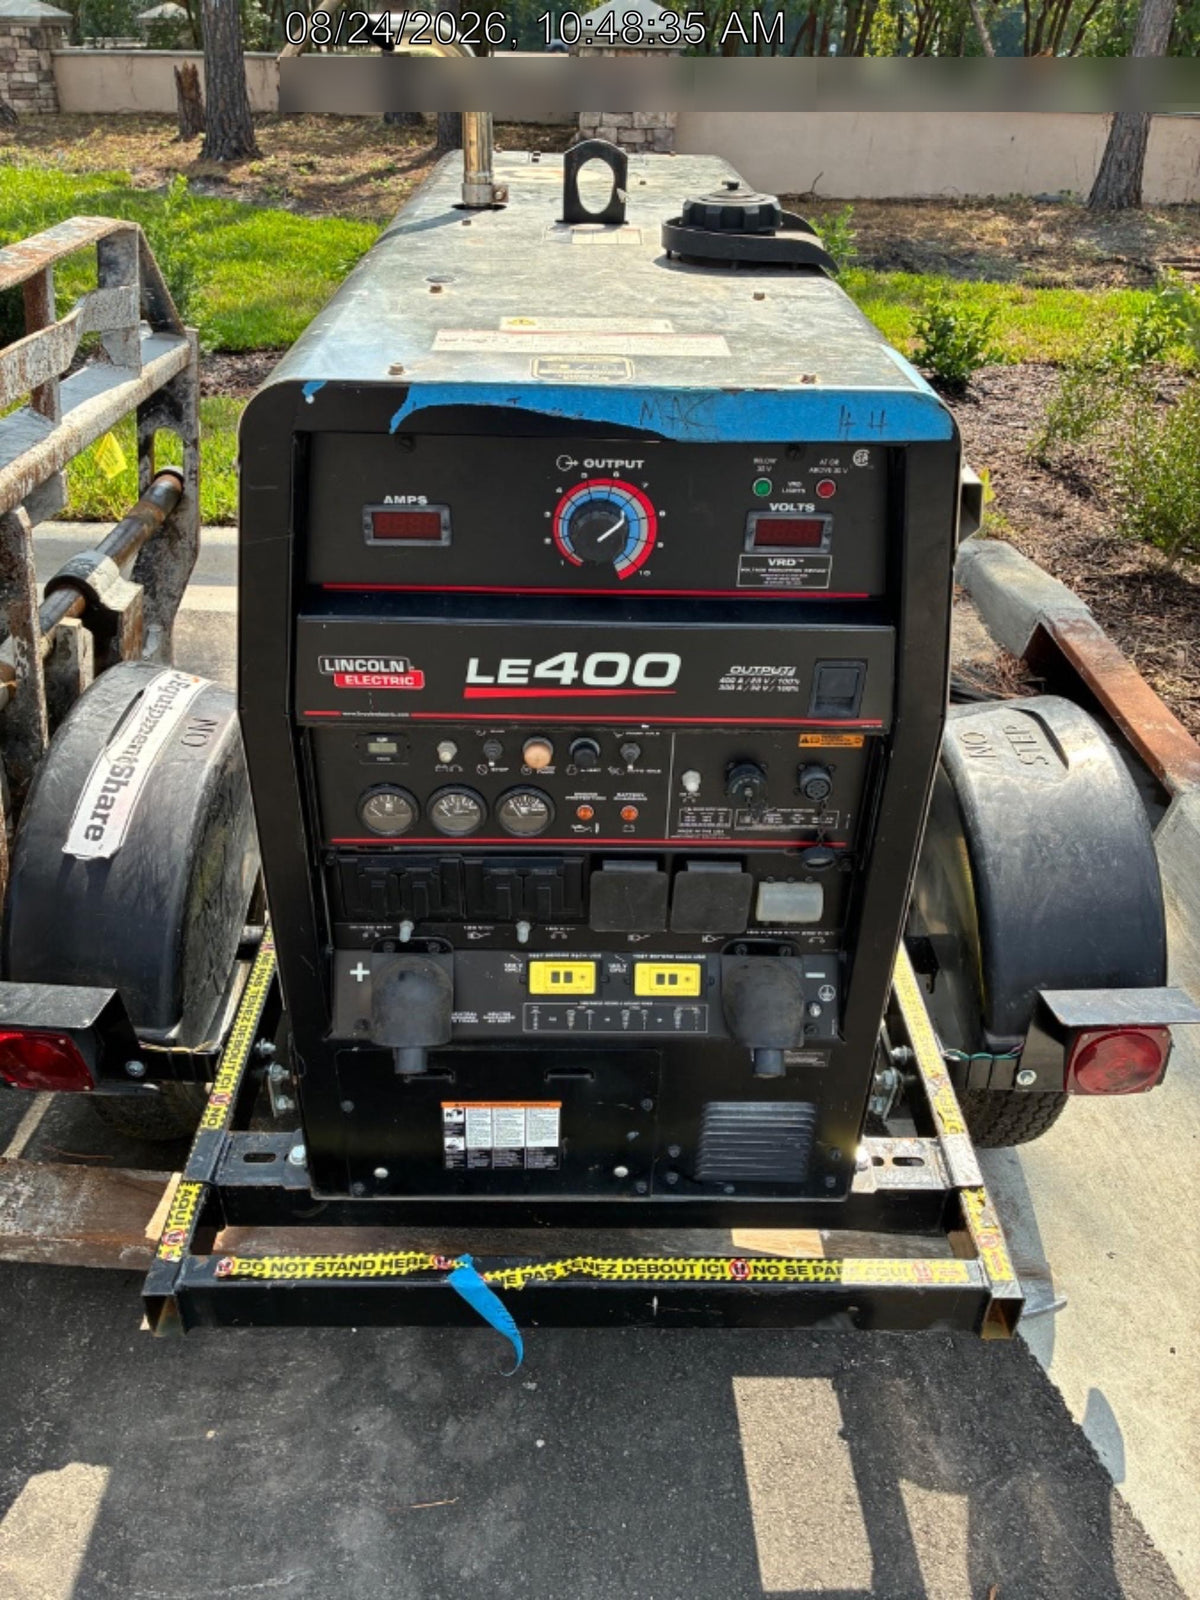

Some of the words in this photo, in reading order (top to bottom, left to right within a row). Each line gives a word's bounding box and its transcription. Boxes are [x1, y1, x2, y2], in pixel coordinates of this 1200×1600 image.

[583, 459, 645, 469] OUTPUT
[384, 495, 428, 505] AMPS
[769, 503, 816, 513] VOLTS
[324, 659, 405, 673] LINCOLN
[466, 652, 682, 687] LE400
[345, 675, 415, 686] ELECTRIC
[181, 718, 218, 748] NO
[960, 731, 997, 758] NO
[225, 1025, 248, 1072] DEBOUT
[221, 1073, 233, 1089] ICI
[207, 1107, 223, 1126] NO
[238, 1261, 266, 1272] DO
[271, 1261, 310, 1273] NOT
[313, 1260, 376, 1272] STAND
[622, 1263, 697, 1274] DEBOUT
[701, 1263, 725, 1274] ICI
[753, 1263, 781, 1275] NO
[784, 1263, 809, 1275] SE
